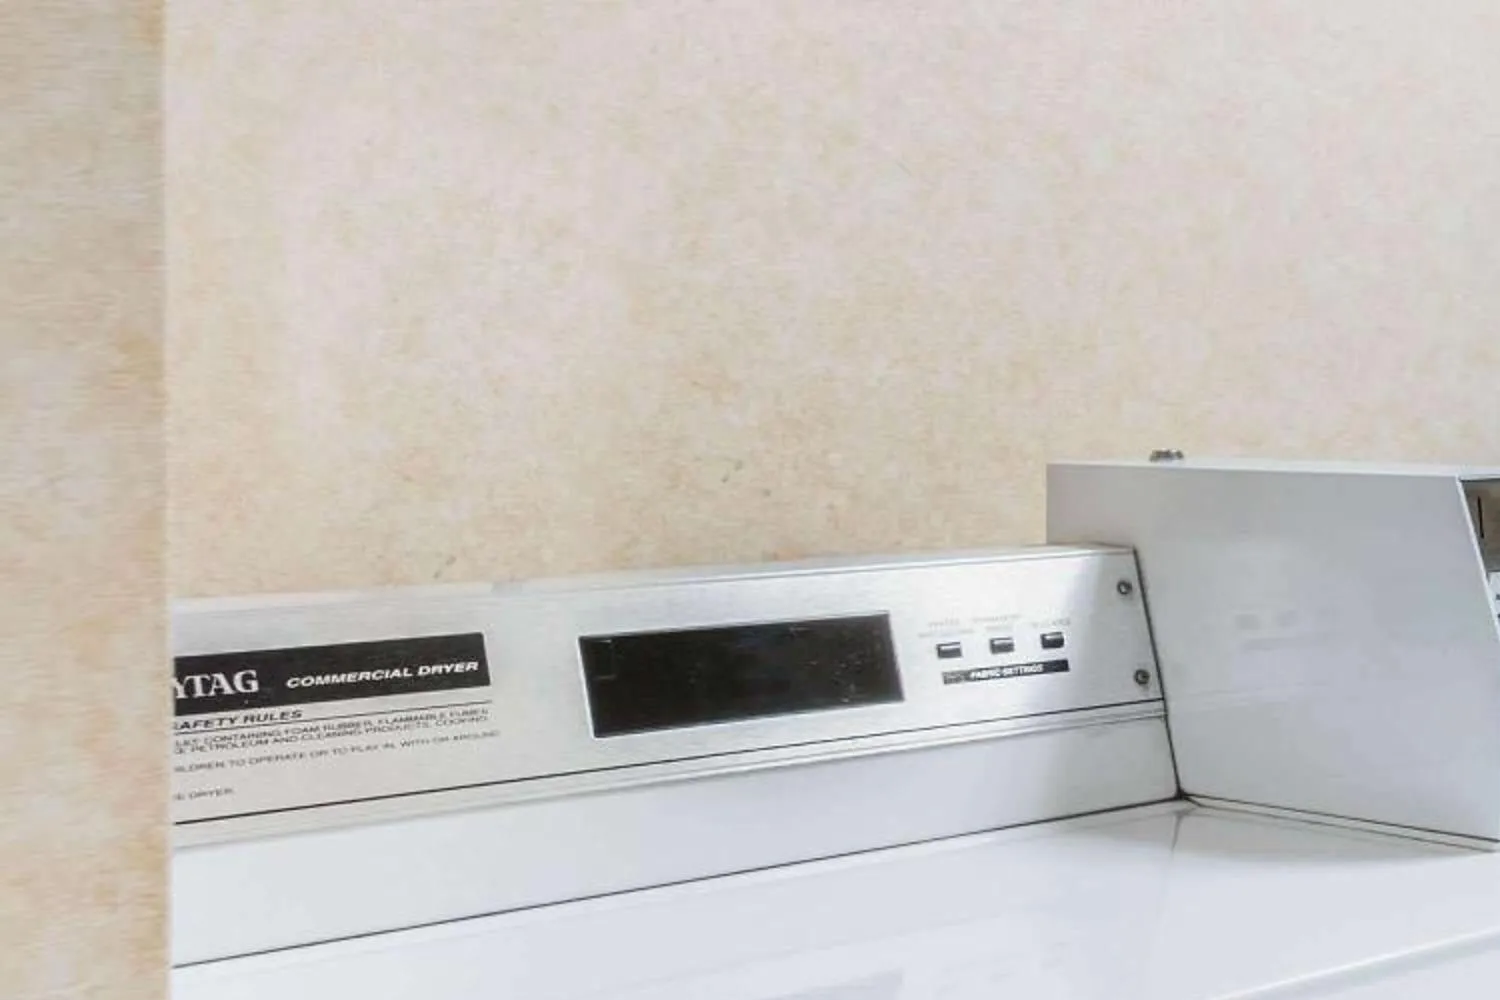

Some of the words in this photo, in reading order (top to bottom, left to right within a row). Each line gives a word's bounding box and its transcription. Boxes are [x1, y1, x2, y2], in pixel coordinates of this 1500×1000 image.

[286, 668, 413, 688] COMMERCIAL
[417, 661, 479, 676] DRYER
[243, 709, 303, 724] RULES
